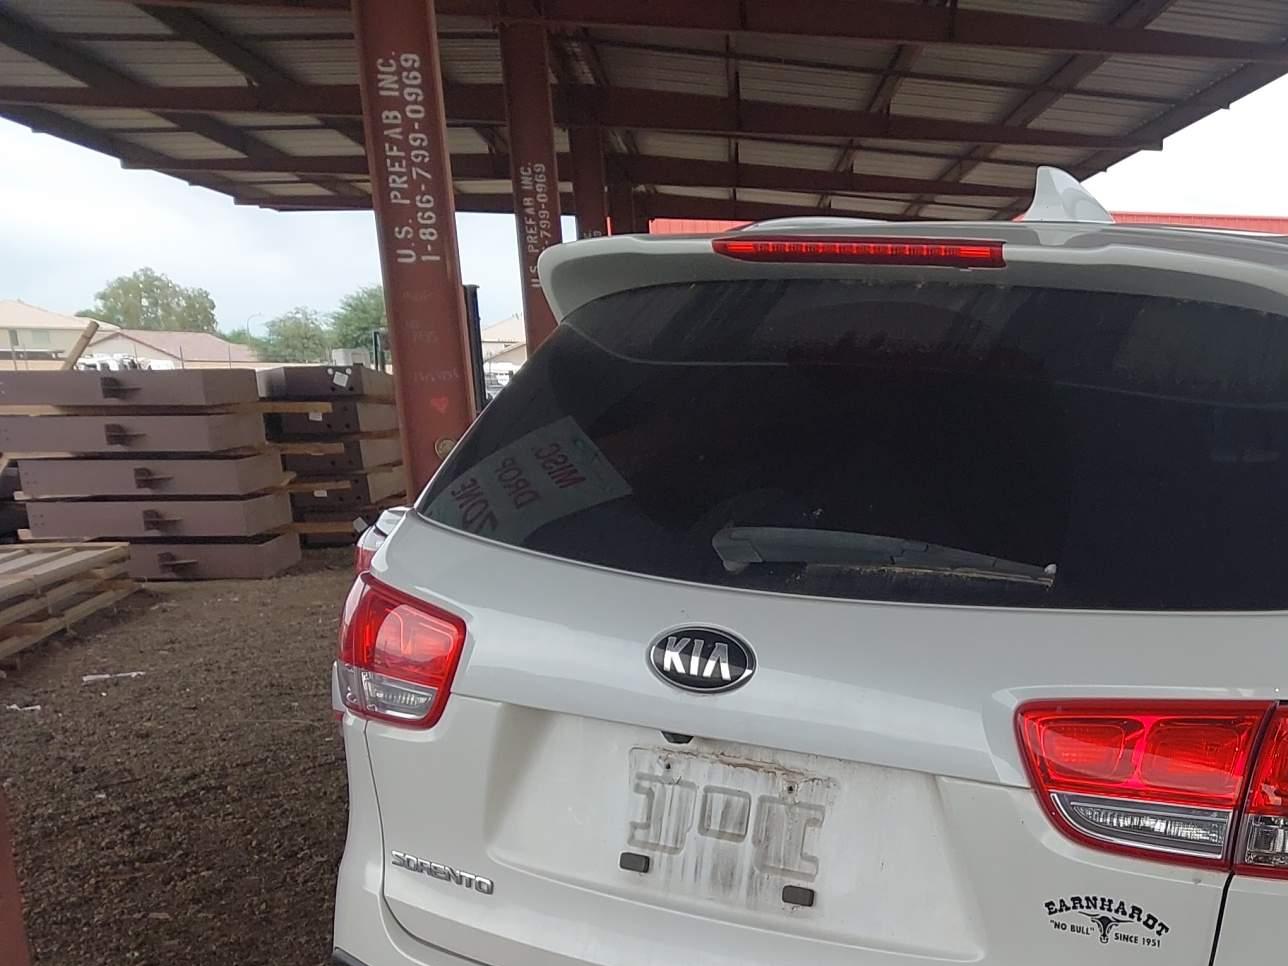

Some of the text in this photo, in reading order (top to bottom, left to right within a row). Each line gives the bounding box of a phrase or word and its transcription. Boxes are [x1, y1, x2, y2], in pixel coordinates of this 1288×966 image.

[376, 51, 418, 263] U.S. PREFAB INC.
[400, 53, 441, 262] 1-866-799-0969
[522, 197, 539, 253] PREFAB
[663, 636, 731, 681] KIA
[391, 850, 494, 895] SORENTO
[1044, 896, 1170, 937] EARNHARDT
[1049, 919, 1095, 935] "NO BULL"
[1114, 932, 1161, 948] SINCE 1951
